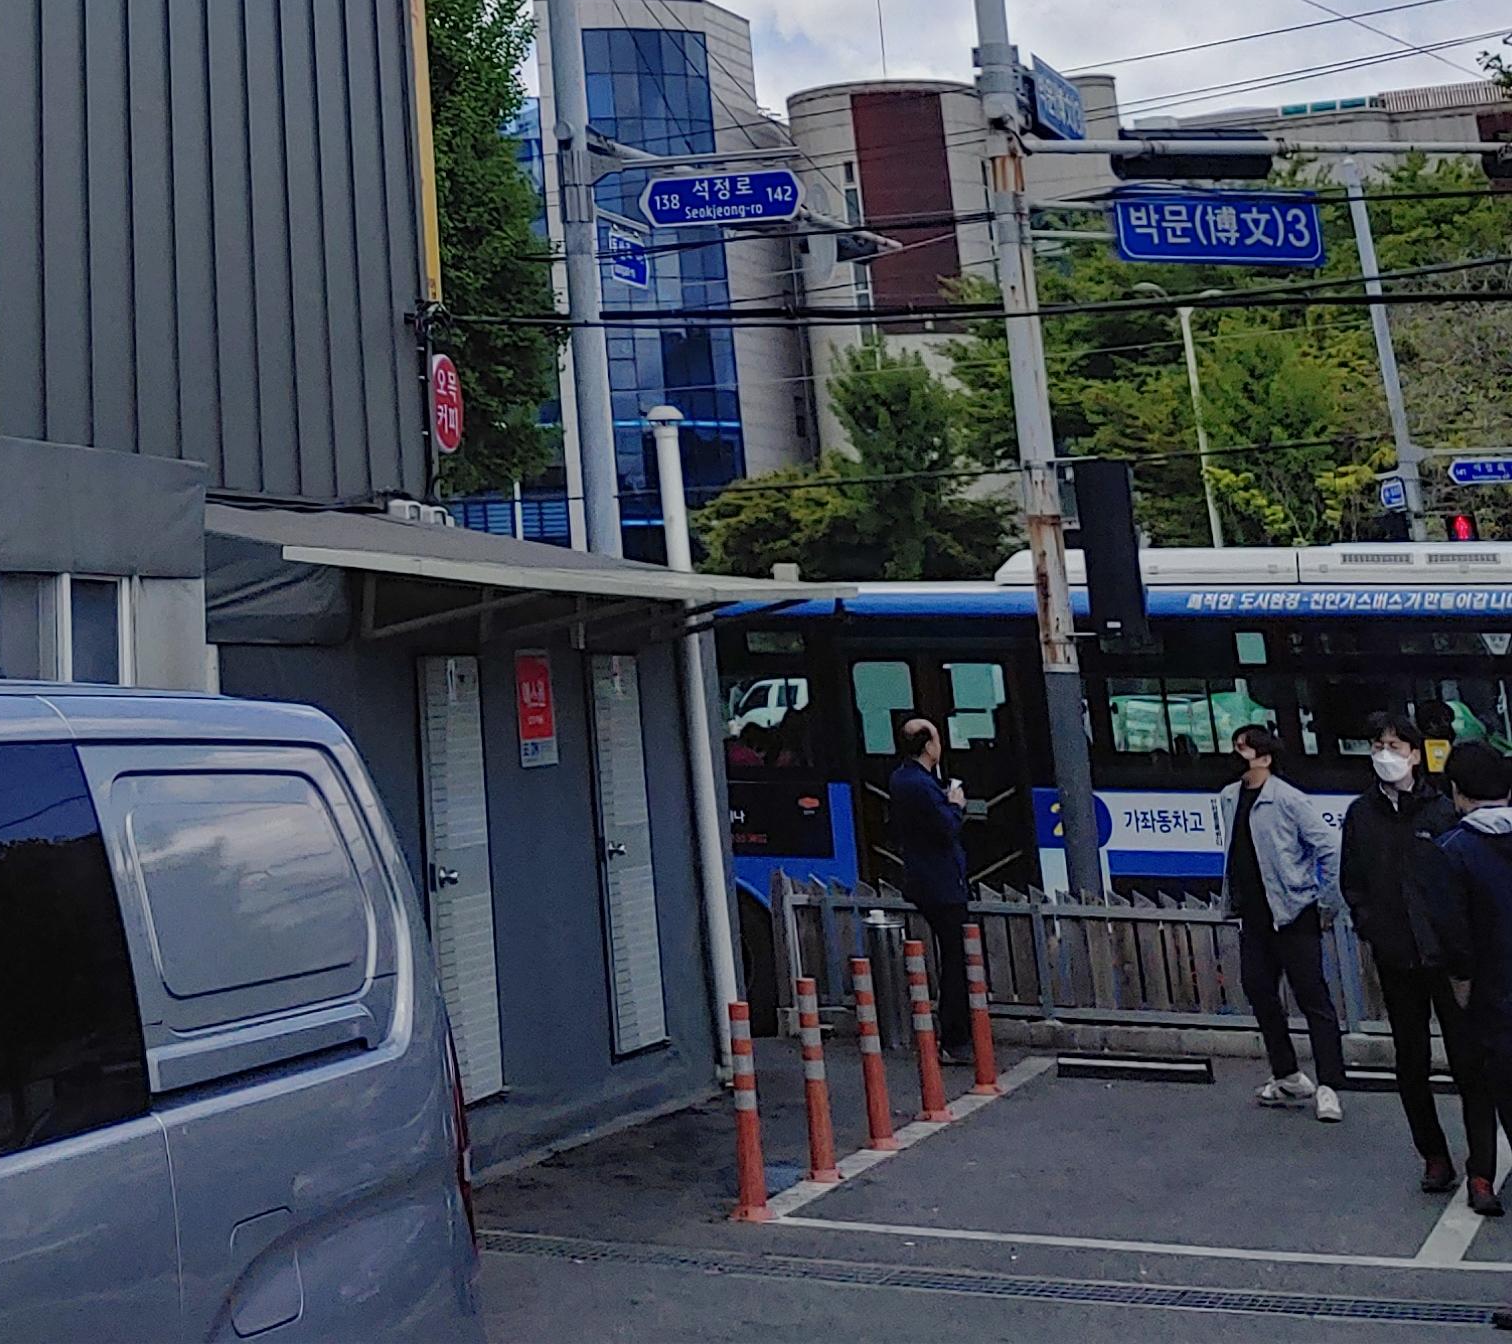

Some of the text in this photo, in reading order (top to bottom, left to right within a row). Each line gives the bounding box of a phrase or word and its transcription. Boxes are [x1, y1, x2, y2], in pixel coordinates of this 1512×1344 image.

[692, 176, 753, 201] 석정로
[766, 186, 792, 203] 142
[654, 194, 680, 210] 138
[685, 204, 763, 219] Seokjeong-ro
[437, 403, 458, 437] 커피
[1124, 809, 1205, 834] 가좌동차고
